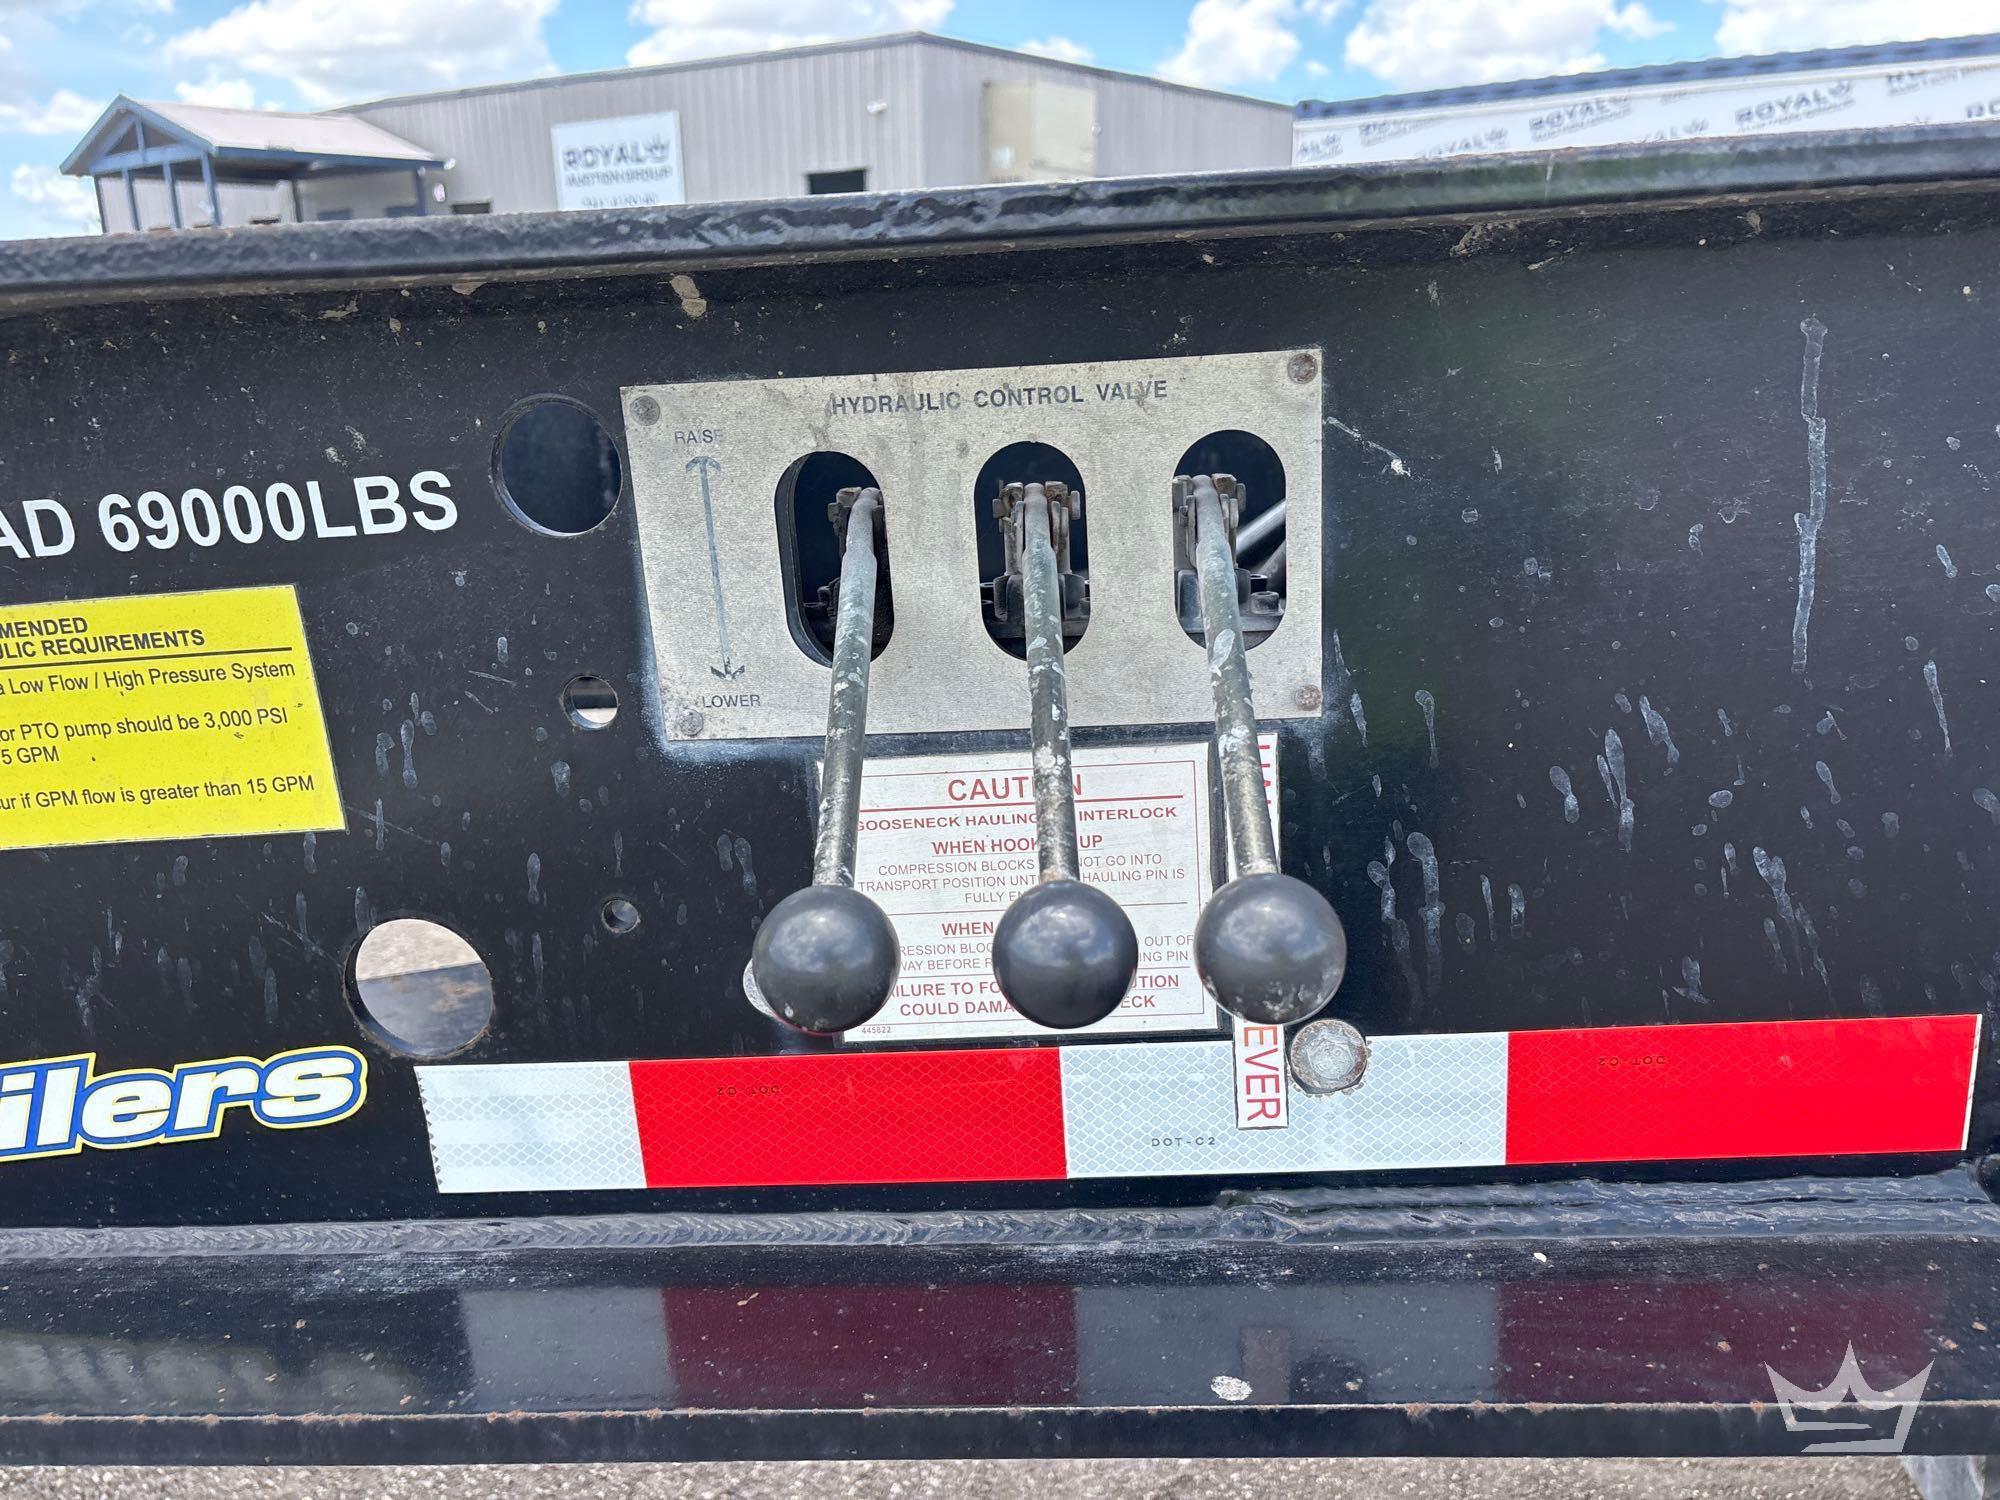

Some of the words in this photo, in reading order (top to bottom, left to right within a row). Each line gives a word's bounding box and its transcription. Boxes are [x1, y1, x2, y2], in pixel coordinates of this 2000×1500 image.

[1736, 88, 1828, 123] ROYAL
[564, 143, 644, 168] ROYAL
[832, 391, 961, 415] HYDRAULIC
[974, 384, 1084, 408] CONTROL
[1096, 380, 1167, 402] VALVE
[99, 470, 458, 551] 69000LBS
[41, 629, 205, 656] REQUIREMENTS
[8, 678, 44, 695] Low
[48, 674, 88, 692] Flow
[104, 669, 145, 691] High
[148, 667, 227, 686] Pressure
[231, 663, 295, 684] System
[702, 694, 760, 709] LOWER
[20, 721, 59, 739] PTO
[64, 722, 112, 741] pump
[119, 715, 173, 735] should
[178, 712, 200, 730] be
[205, 710, 253, 730] 3,000
[258, 707, 289, 725] PSI
[17, 745, 59, 763] GPM
[20, 792, 30, 808] if
[35, 788, 78, 807] GPM
[81, 788, 116, 804] flow
[120, 786, 135, 803] is
[140, 784, 199, 805] greater
[204, 780, 241, 797] than
[247, 777, 267, 794] 15
[272, 774, 315, 793] GPM
[1079, 806, 1177, 821] INTERLOCK
[932, 840, 985, 855] WHEN
[878, 861, 977, 877] COMPRESSION
[981, 858, 1035, 872] BLOCKS
[1105, 854, 1126, 866] GO
[1131, 853, 1162, 866] INTO
[859, 878, 938, 893] TRANSPORT
[942, 876, 1006, 890] POSITION
[1010, 874, 1039, 887] UNT
[1082, 870, 1141, 882] HAULING
[1146, 868, 1168, 880] PIN
[1173, 868, 1185, 879] IS
[965, 891, 1004, 904] FULLY
[941, 921, 994, 937] WHEN
[1144, 935, 1171, 947] OUT
[1176, 934, 1194, 945] OF
[927, 959, 980, 973] BEFORE
[953, 982, 976, 996] TO
[900, 1003, 961, 1018] COULD
[1243, 1021, 1281, 1122] EVER
[0, 1050, 364, 1155] ilers
[1151, 1136, 1216, 1147] DOT-C2
